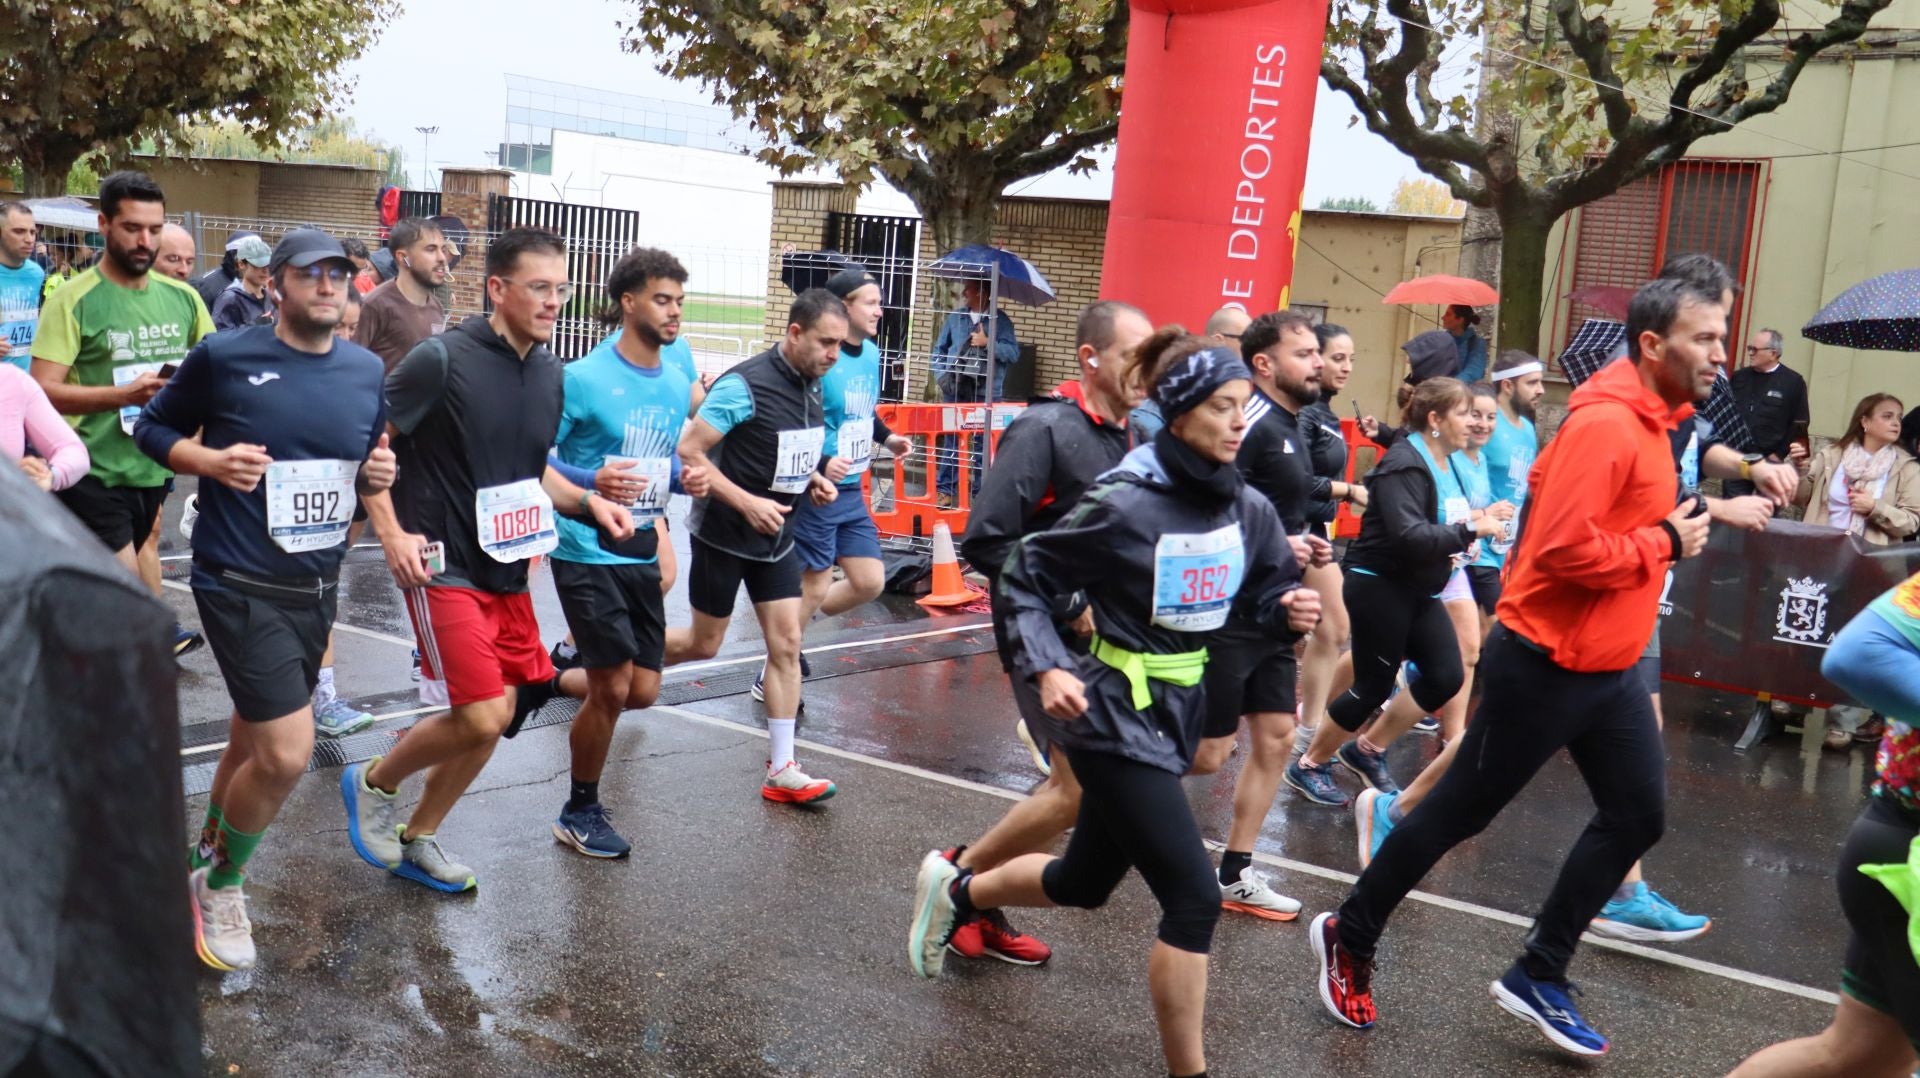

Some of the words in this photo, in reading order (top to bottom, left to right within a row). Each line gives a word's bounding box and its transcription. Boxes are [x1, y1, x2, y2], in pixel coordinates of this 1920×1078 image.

[1226, 44, 1287, 261] DEPORTES
[10, 325, 32, 344] 474
[138, 323, 181, 340] aecc
[293, 491, 339, 525] 992
[636, 483, 657, 507] 44
[493, 505, 540, 541] 1080
[1181, 564, 1229, 603] 362
